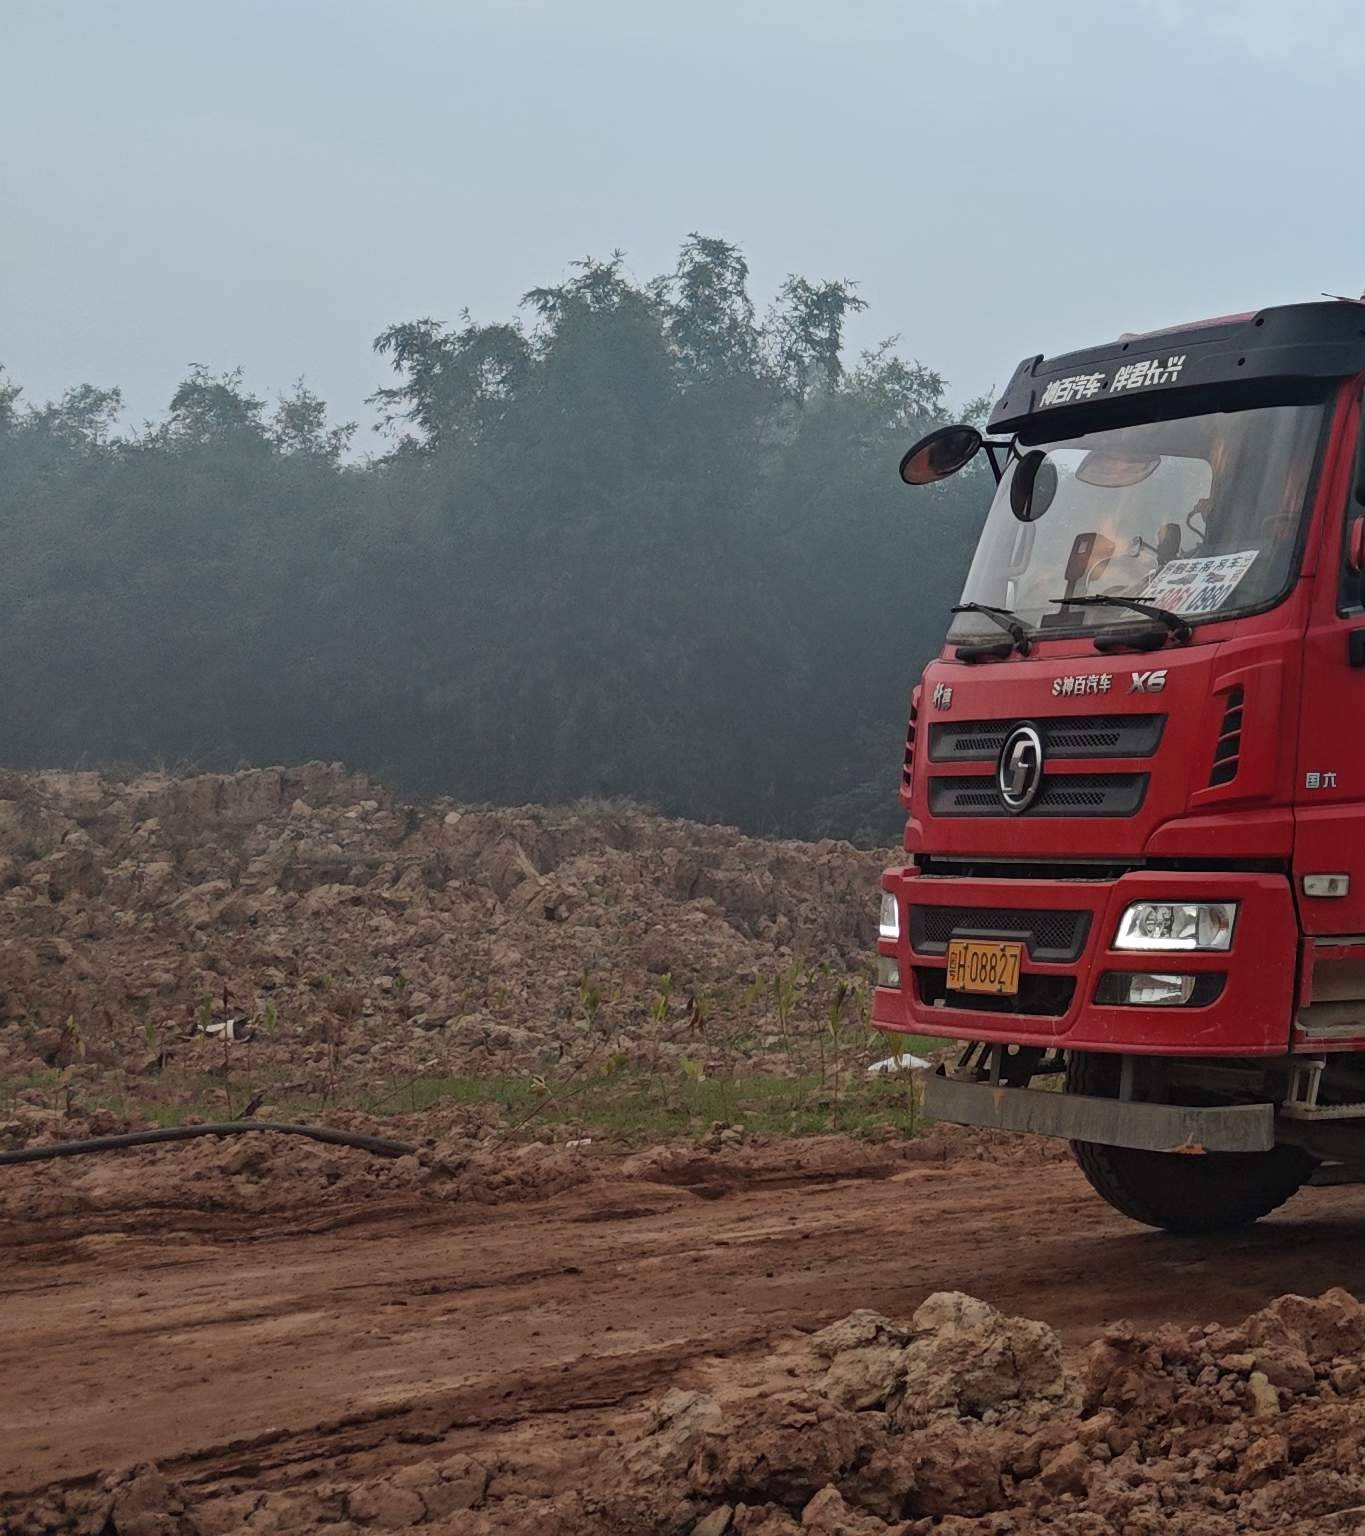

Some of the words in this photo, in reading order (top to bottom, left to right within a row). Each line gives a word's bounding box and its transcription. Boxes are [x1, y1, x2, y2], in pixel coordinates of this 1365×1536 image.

[1039, 372, 1107, 408] 神百汽车
[1109, 355, 1187, 393] 伴君长兴
[1127, 669, 1168, 694] X6
[1305, 772, 1337, 789] 国六
